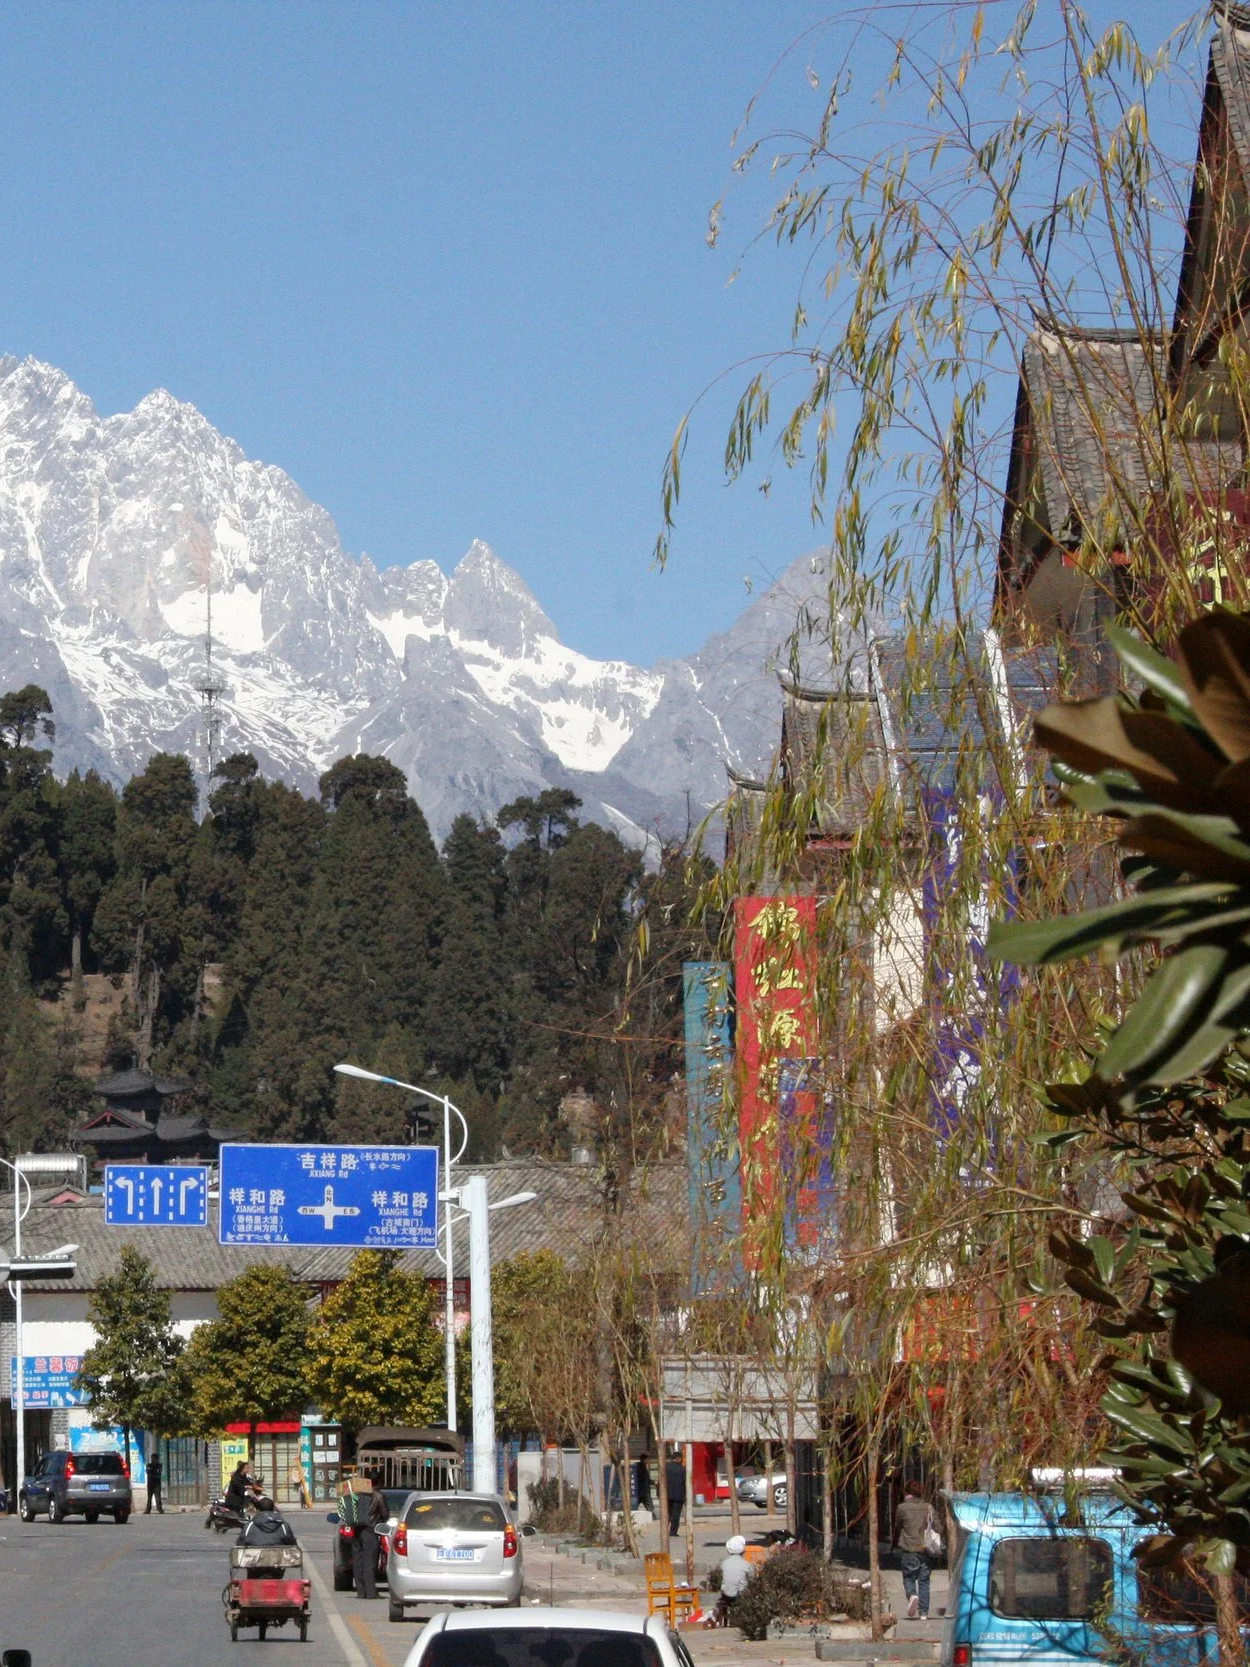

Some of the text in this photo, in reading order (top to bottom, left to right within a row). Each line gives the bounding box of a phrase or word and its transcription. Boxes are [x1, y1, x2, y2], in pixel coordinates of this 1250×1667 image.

[301, 1152, 358, 1170] 吉祥路
[309, 1170, 348, 1178] JIXIANG Rd
[229, 1188, 286, 1206] 祥和路
[372, 1191, 428, 1208] 祥和路
[378, 1208, 408, 1216] XIANGHE
